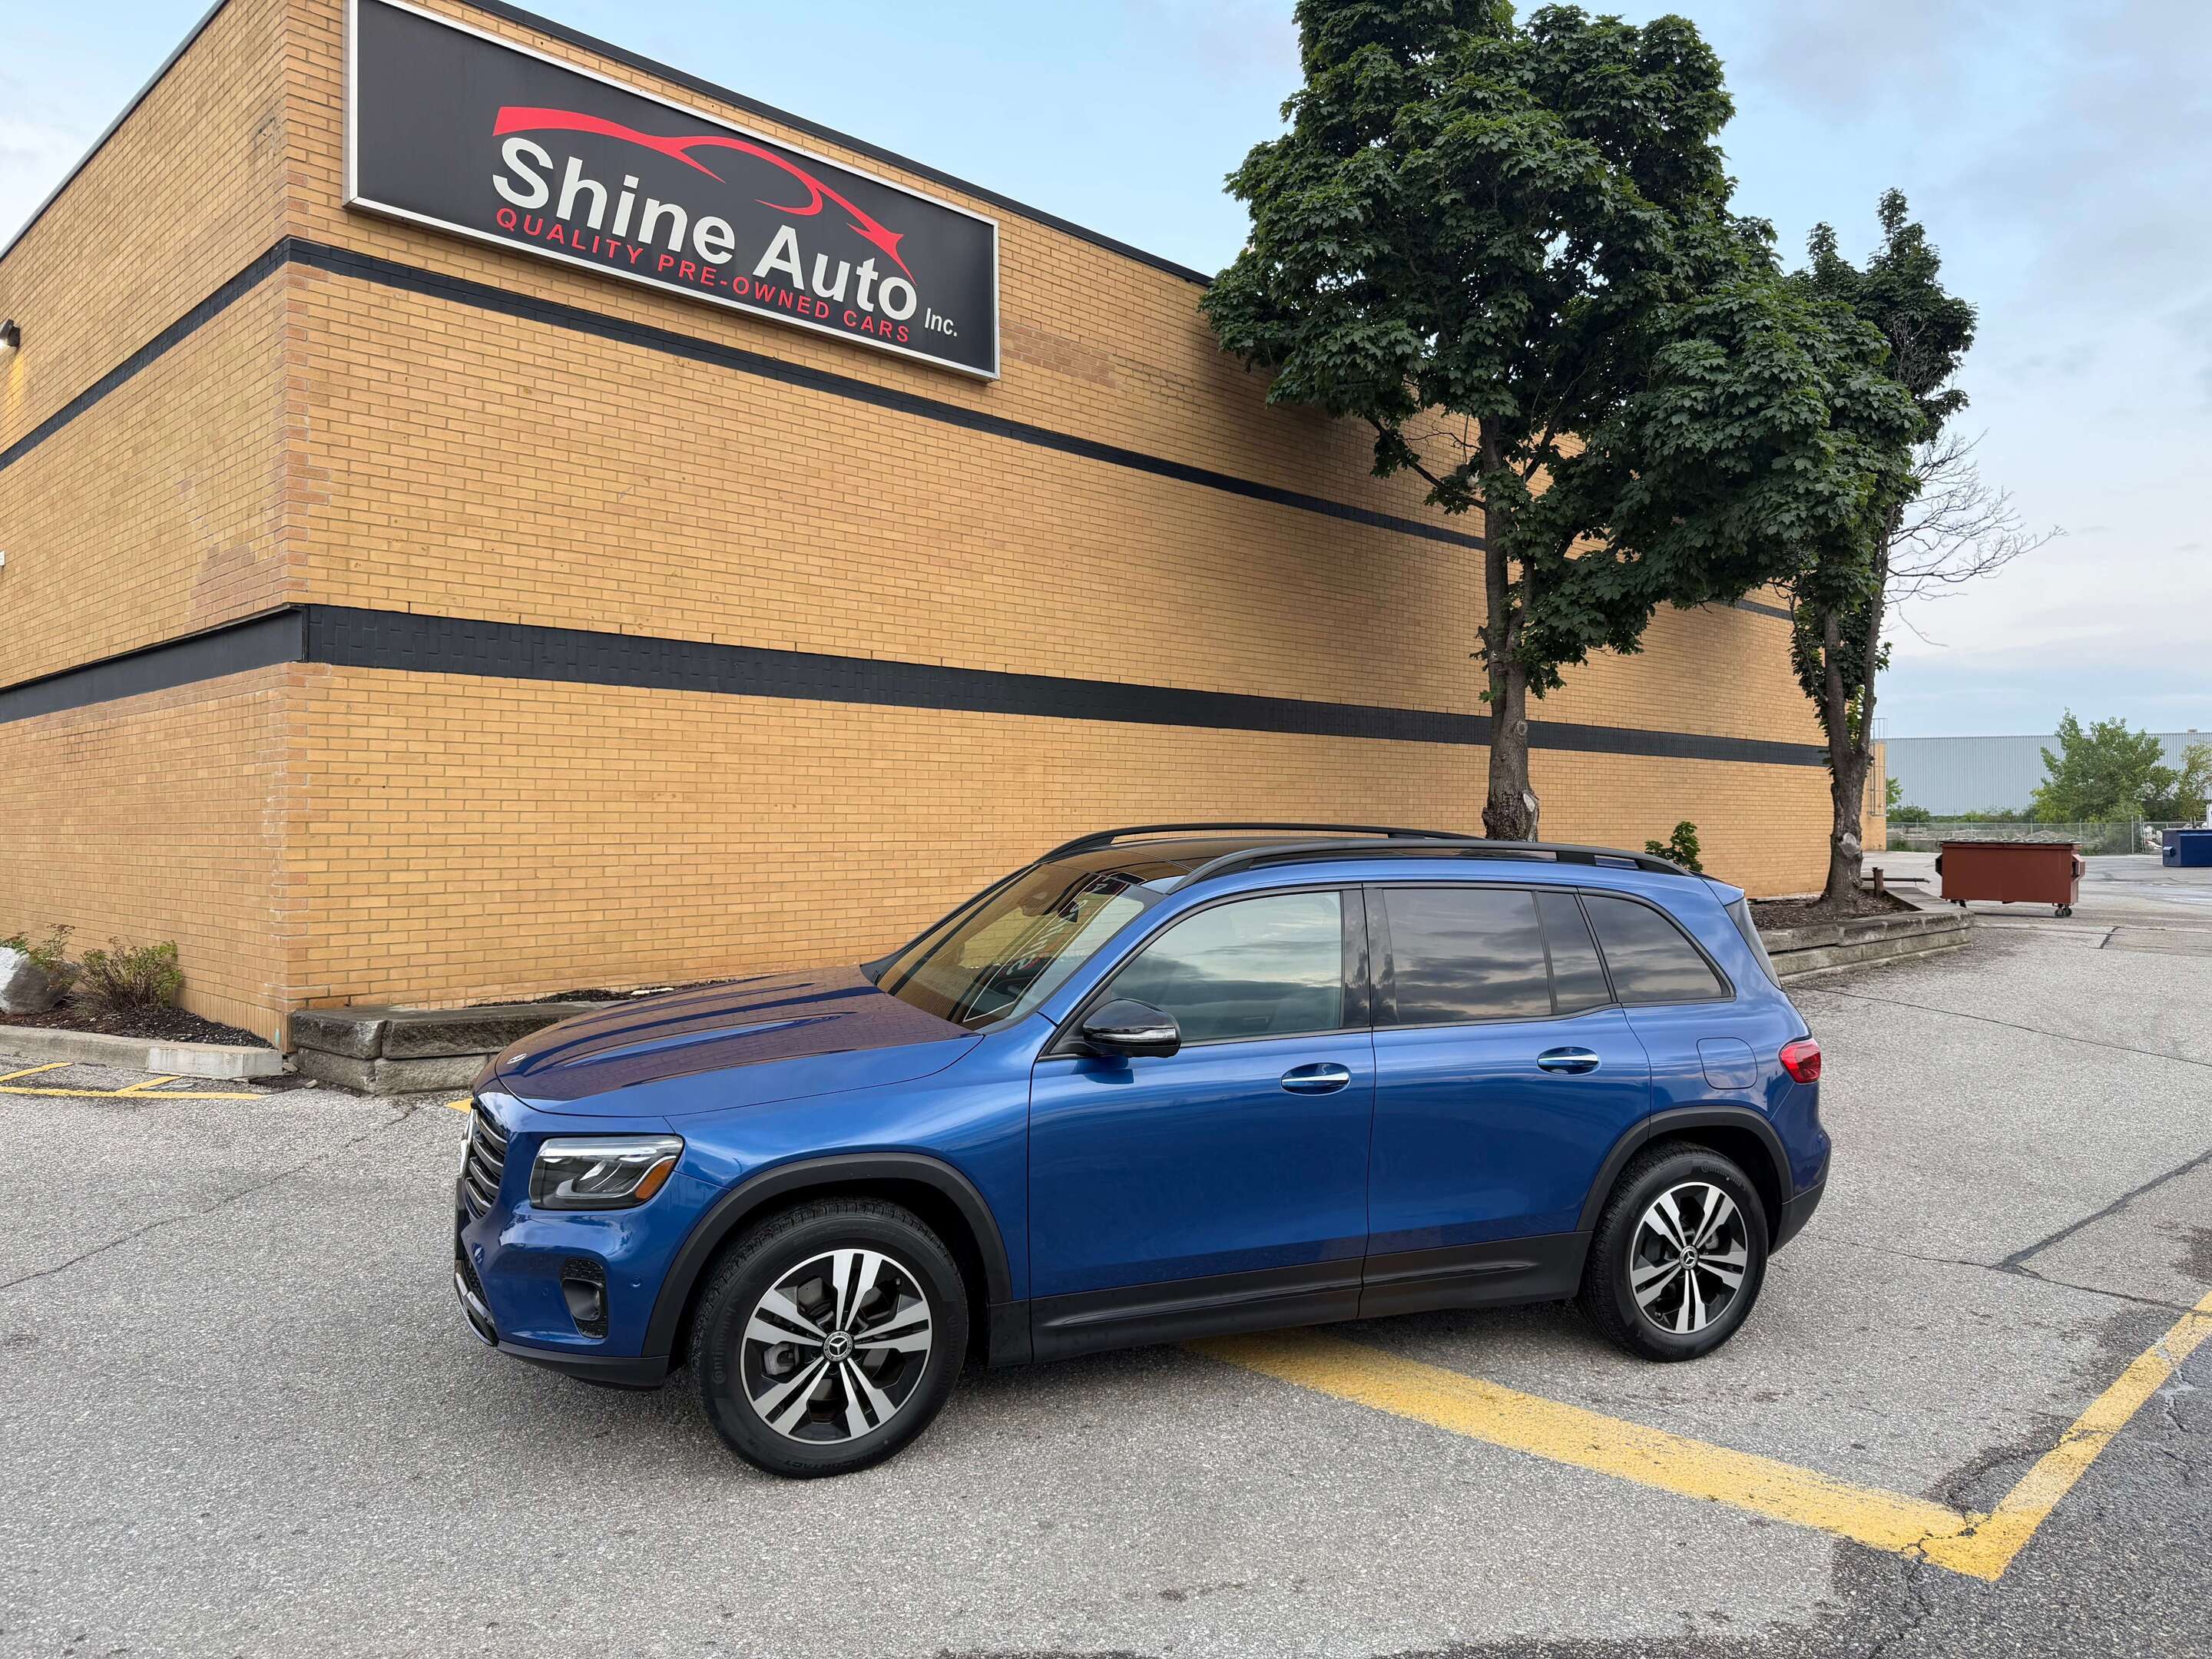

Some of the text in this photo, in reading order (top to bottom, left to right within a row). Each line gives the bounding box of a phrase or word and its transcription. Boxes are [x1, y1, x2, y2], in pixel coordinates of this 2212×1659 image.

[492, 137, 959, 338] Shine Auto Inc.
[495, 207, 911, 343] QUALITY PRE-OWNED CARS
